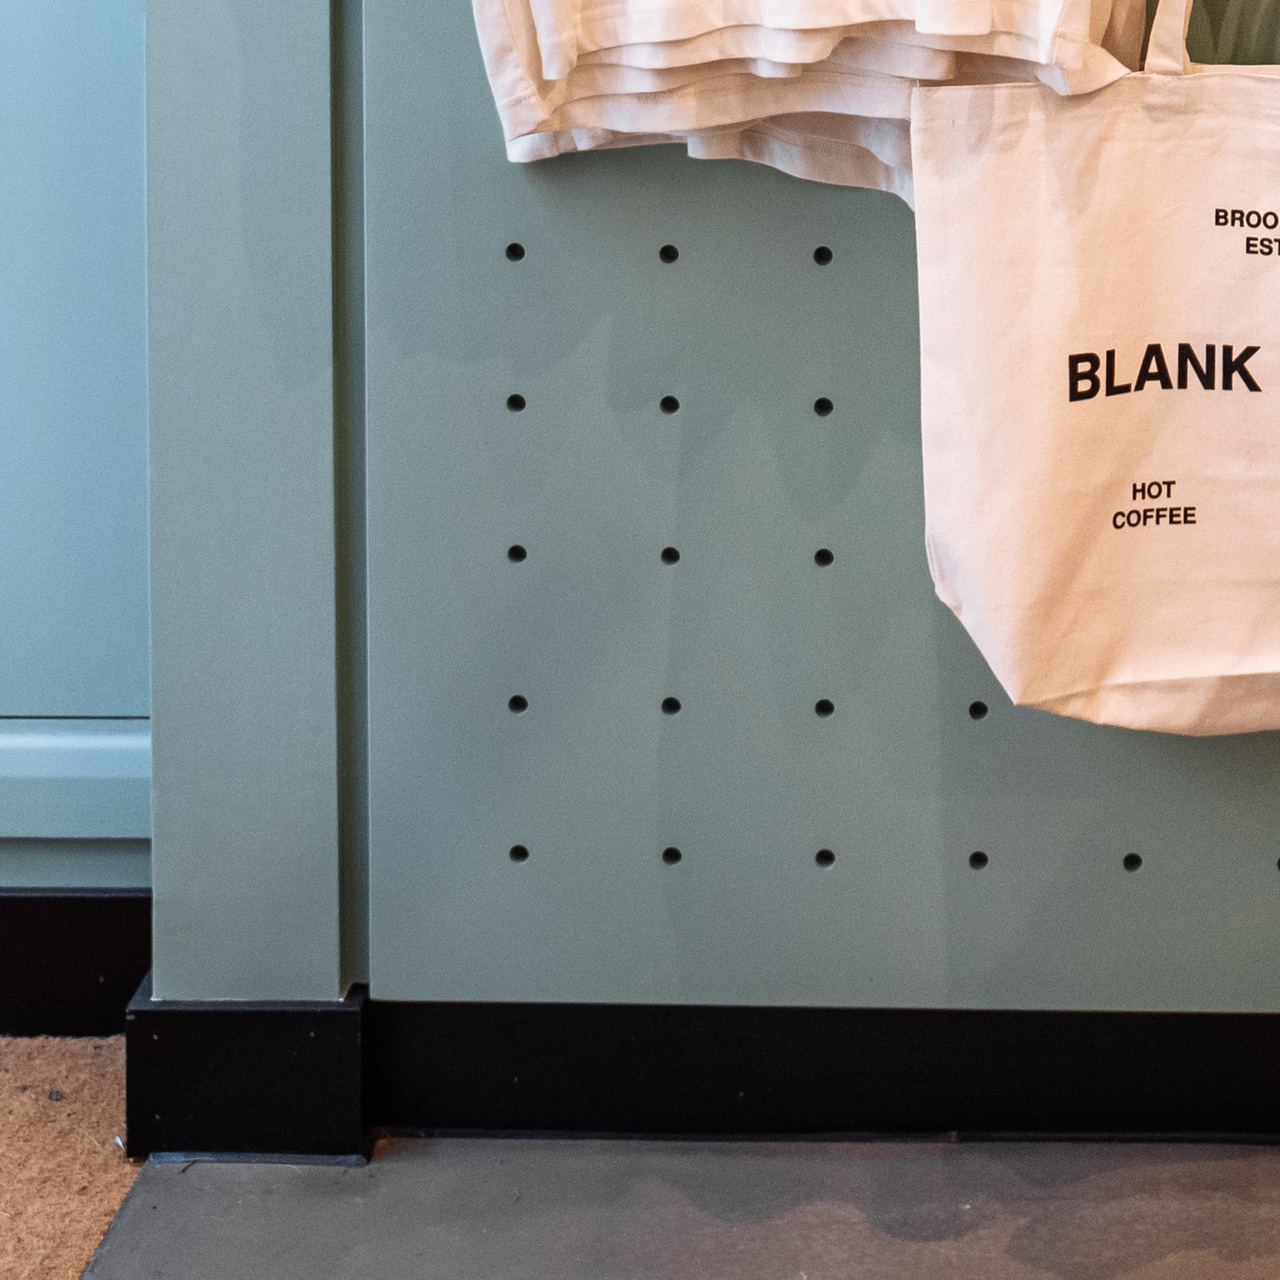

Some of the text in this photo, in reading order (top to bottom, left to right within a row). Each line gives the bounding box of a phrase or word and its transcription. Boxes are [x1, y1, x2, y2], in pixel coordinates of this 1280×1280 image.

[1068, 342, 1263, 403] BLANK
[1132, 480, 1176, 501] HOT
[1112, 506, 1197, 530] COFFEE
